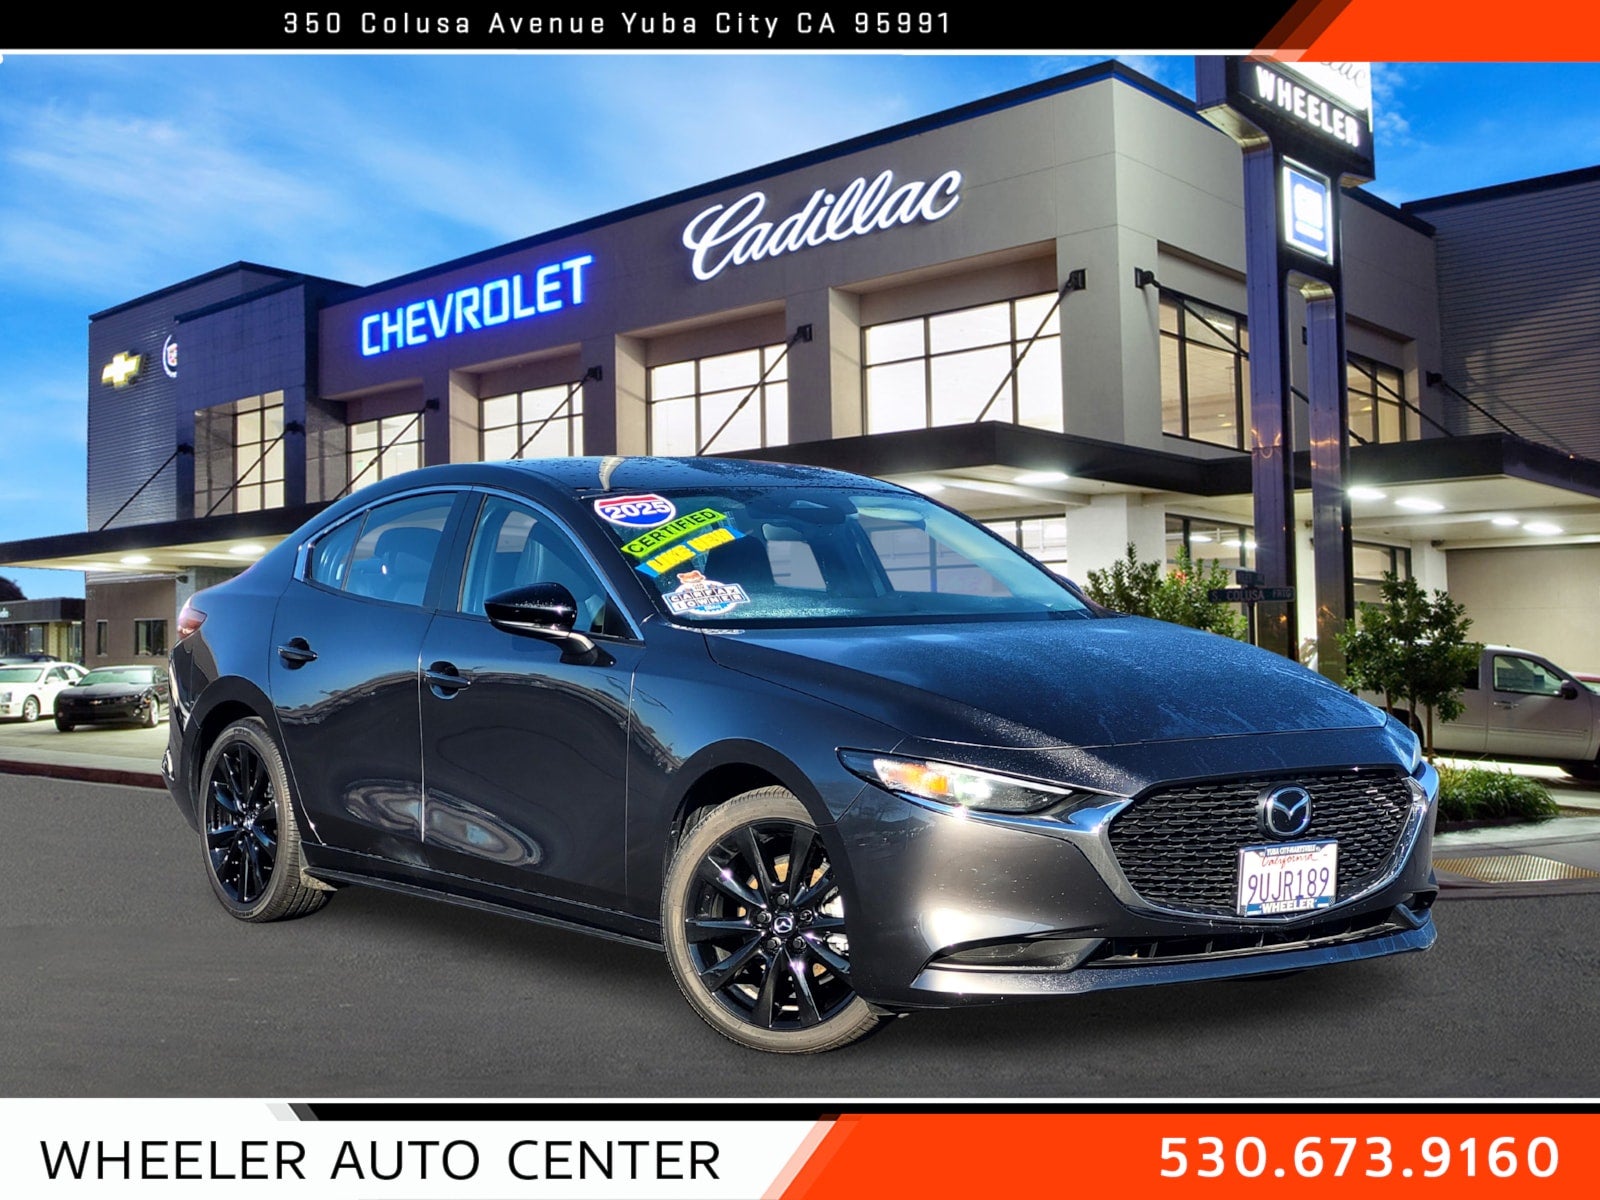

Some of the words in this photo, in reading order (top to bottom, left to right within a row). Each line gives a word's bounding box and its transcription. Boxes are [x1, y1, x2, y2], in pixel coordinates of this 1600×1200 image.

[1254, 64, 1360, 147] WHEELER
[682, 169, 963, 281] Cadillac
[360, 254, 594, 357] CHEVROLET
[604, 500, 671, 521] 2025
[627, 510, 717, 554] CERTIFIED
[669, 586, 737, 602] CARFAX
[1247, 866, 1330, 905] 9UJR189
[1261, 898, 1315, 915] WHEELER
